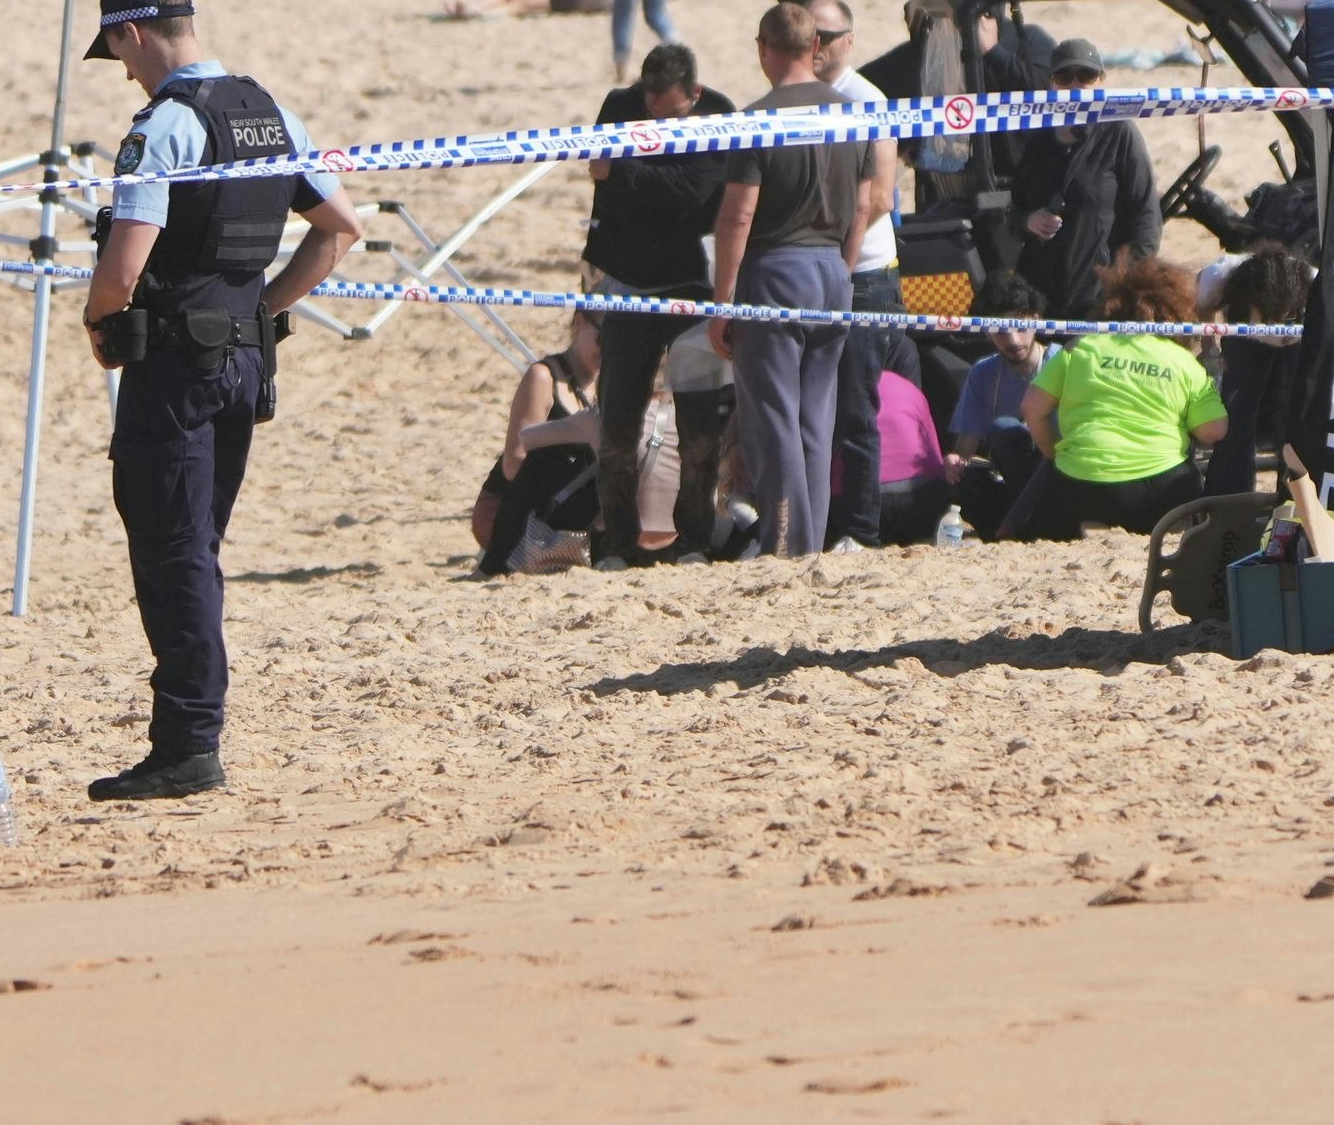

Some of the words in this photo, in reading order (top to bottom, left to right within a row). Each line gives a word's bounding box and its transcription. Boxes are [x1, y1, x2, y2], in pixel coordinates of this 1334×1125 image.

[1010, 101, 1079, 116] POLICE
[245, 118, 263, 127] SOUTH
[262, 117, 280, 125] WALES
[232, 126, 286, 147] POLICE
[319, 288, 376, 300] POLICE
[448, 294, 505, 305] POLICE
[584, 301, 642, 312] POLICE
[716, 306, 771, 318] POLICE
[853, 312, 908, 324] POLICE
[981, 318, 1039, 330] POLICE
[1119, 323, 1176, 335] POLICE
[1247, 325, 1304, 336] POLICE
[1099, 356, 1173, 383] ZUMBA
